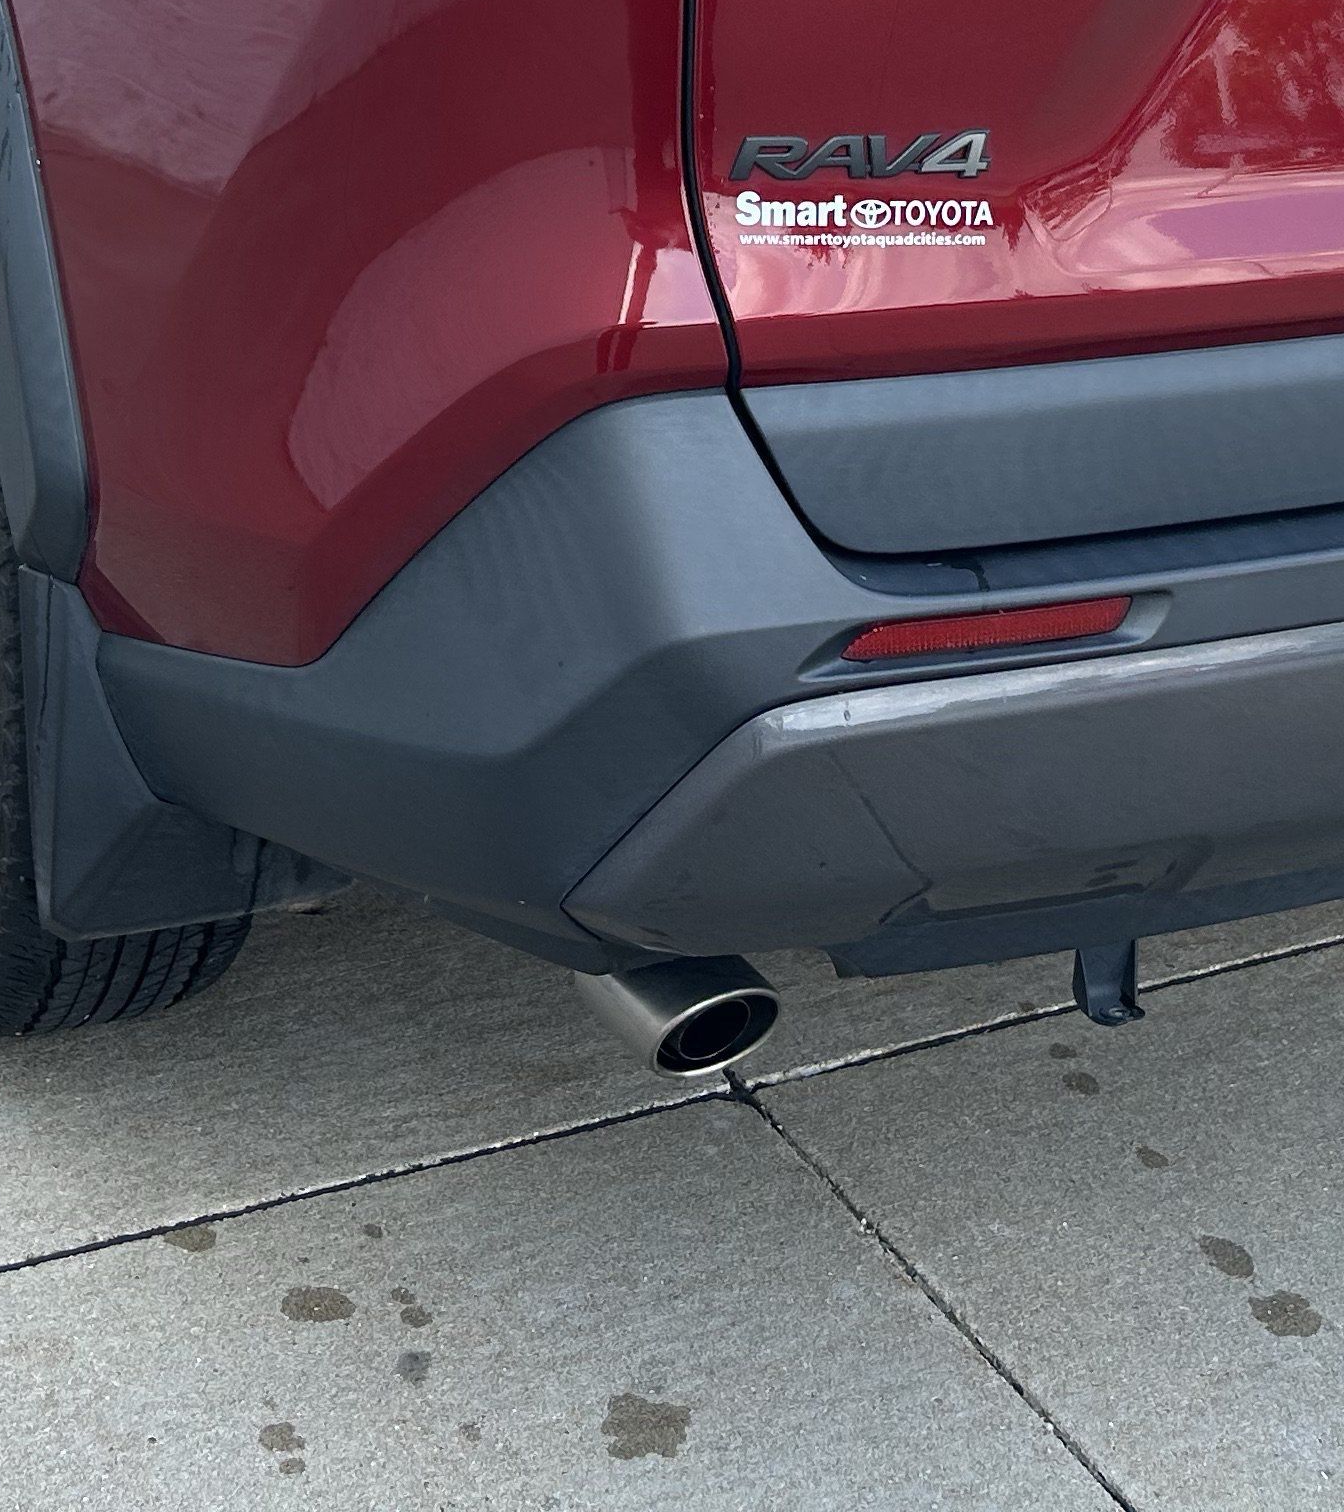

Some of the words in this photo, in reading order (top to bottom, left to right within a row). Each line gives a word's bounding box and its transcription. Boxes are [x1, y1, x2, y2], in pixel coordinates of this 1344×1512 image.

[730, 129, 991, 180] RAV4
[735, 190, 848, 227] Smart
[890, 199, 994, 227] TOYOTA
[739, 231, 986, 249] www.smarttoyotaquadcities.com
